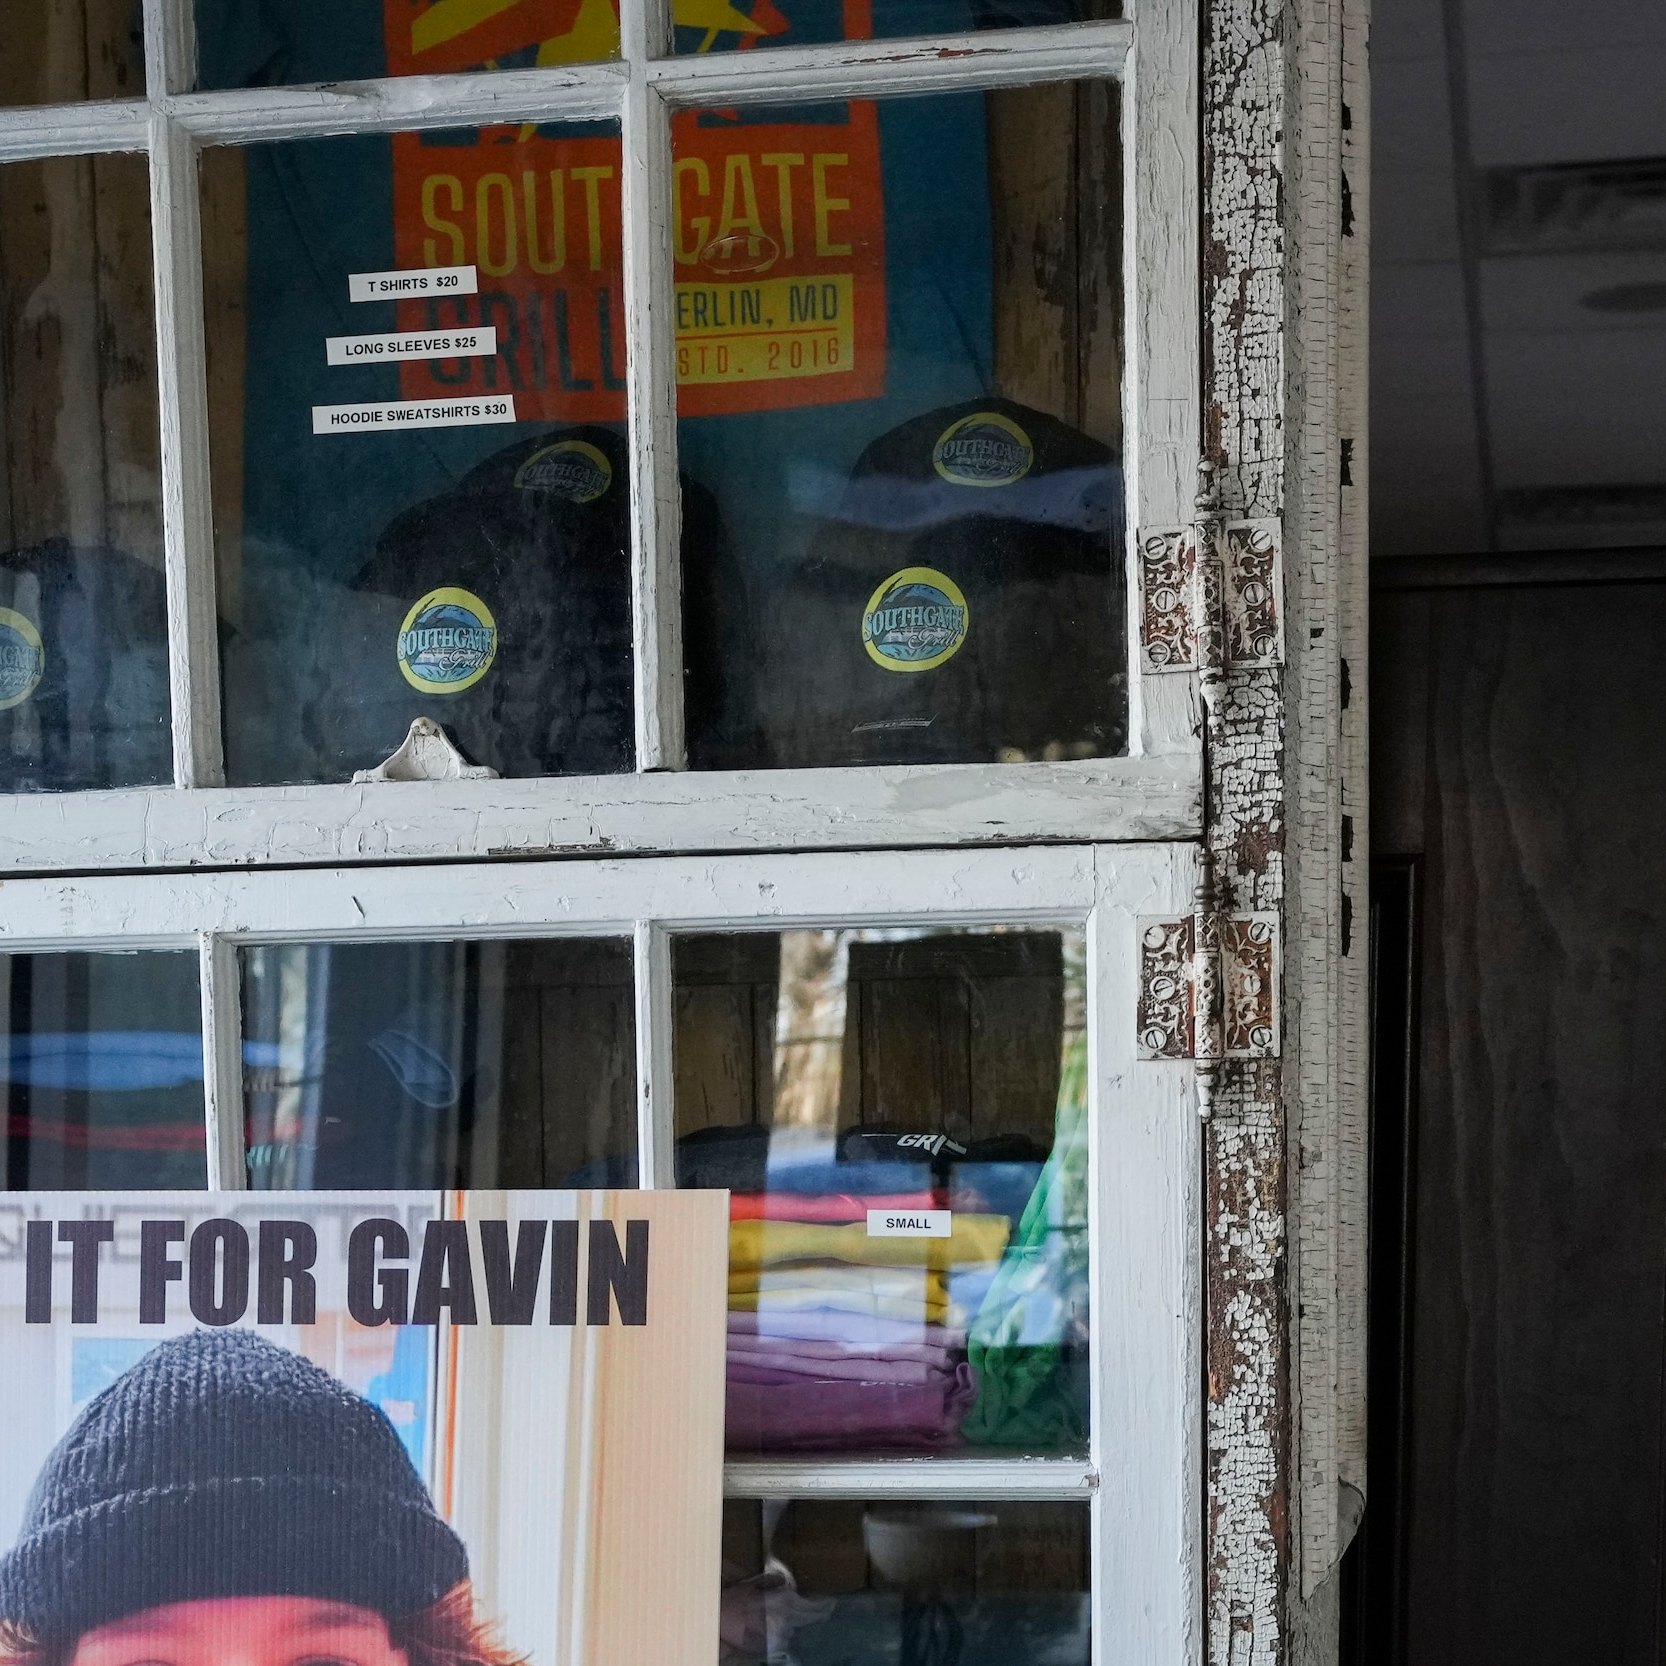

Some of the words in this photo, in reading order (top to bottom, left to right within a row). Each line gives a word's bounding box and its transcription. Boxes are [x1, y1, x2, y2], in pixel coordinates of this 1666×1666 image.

[421, 153, 852, 278] SOUTGATE
[368, 281, 376, 292] T
[379, 277, 428, 292] SHIRTS
[436, 275, 459, 288] $20
[677, 286, 775, 329] ERLIN,
[789, 283, 839, 323] MD
[345, 343, 383, 356] LONG
[387, 338, 451, 353] SLEEVES
[454, 336, 477, 349] $25
[678, 344, 744, 376] STD.
[769, 337, 840, 371] 2016
[331, 410, 383, 425] HOODIE
[387, 404, 481, 422] SWEATSHIRTS
[484, 402, 507, 416] $30
[863, 605, 965, 643] SOUTHGATE
[397, 626, 495, 661] SOUTHGATE
[907, 630, 959, 650] Grill
[439, 650, 489, 671] Grill
[886, 1218, 932, 1229] SMALL
[26, 1219, 114, 1325] IT
[140, 1218, 317, 1326] FOR
[347, 1217, 648, 1327] GAVIN
